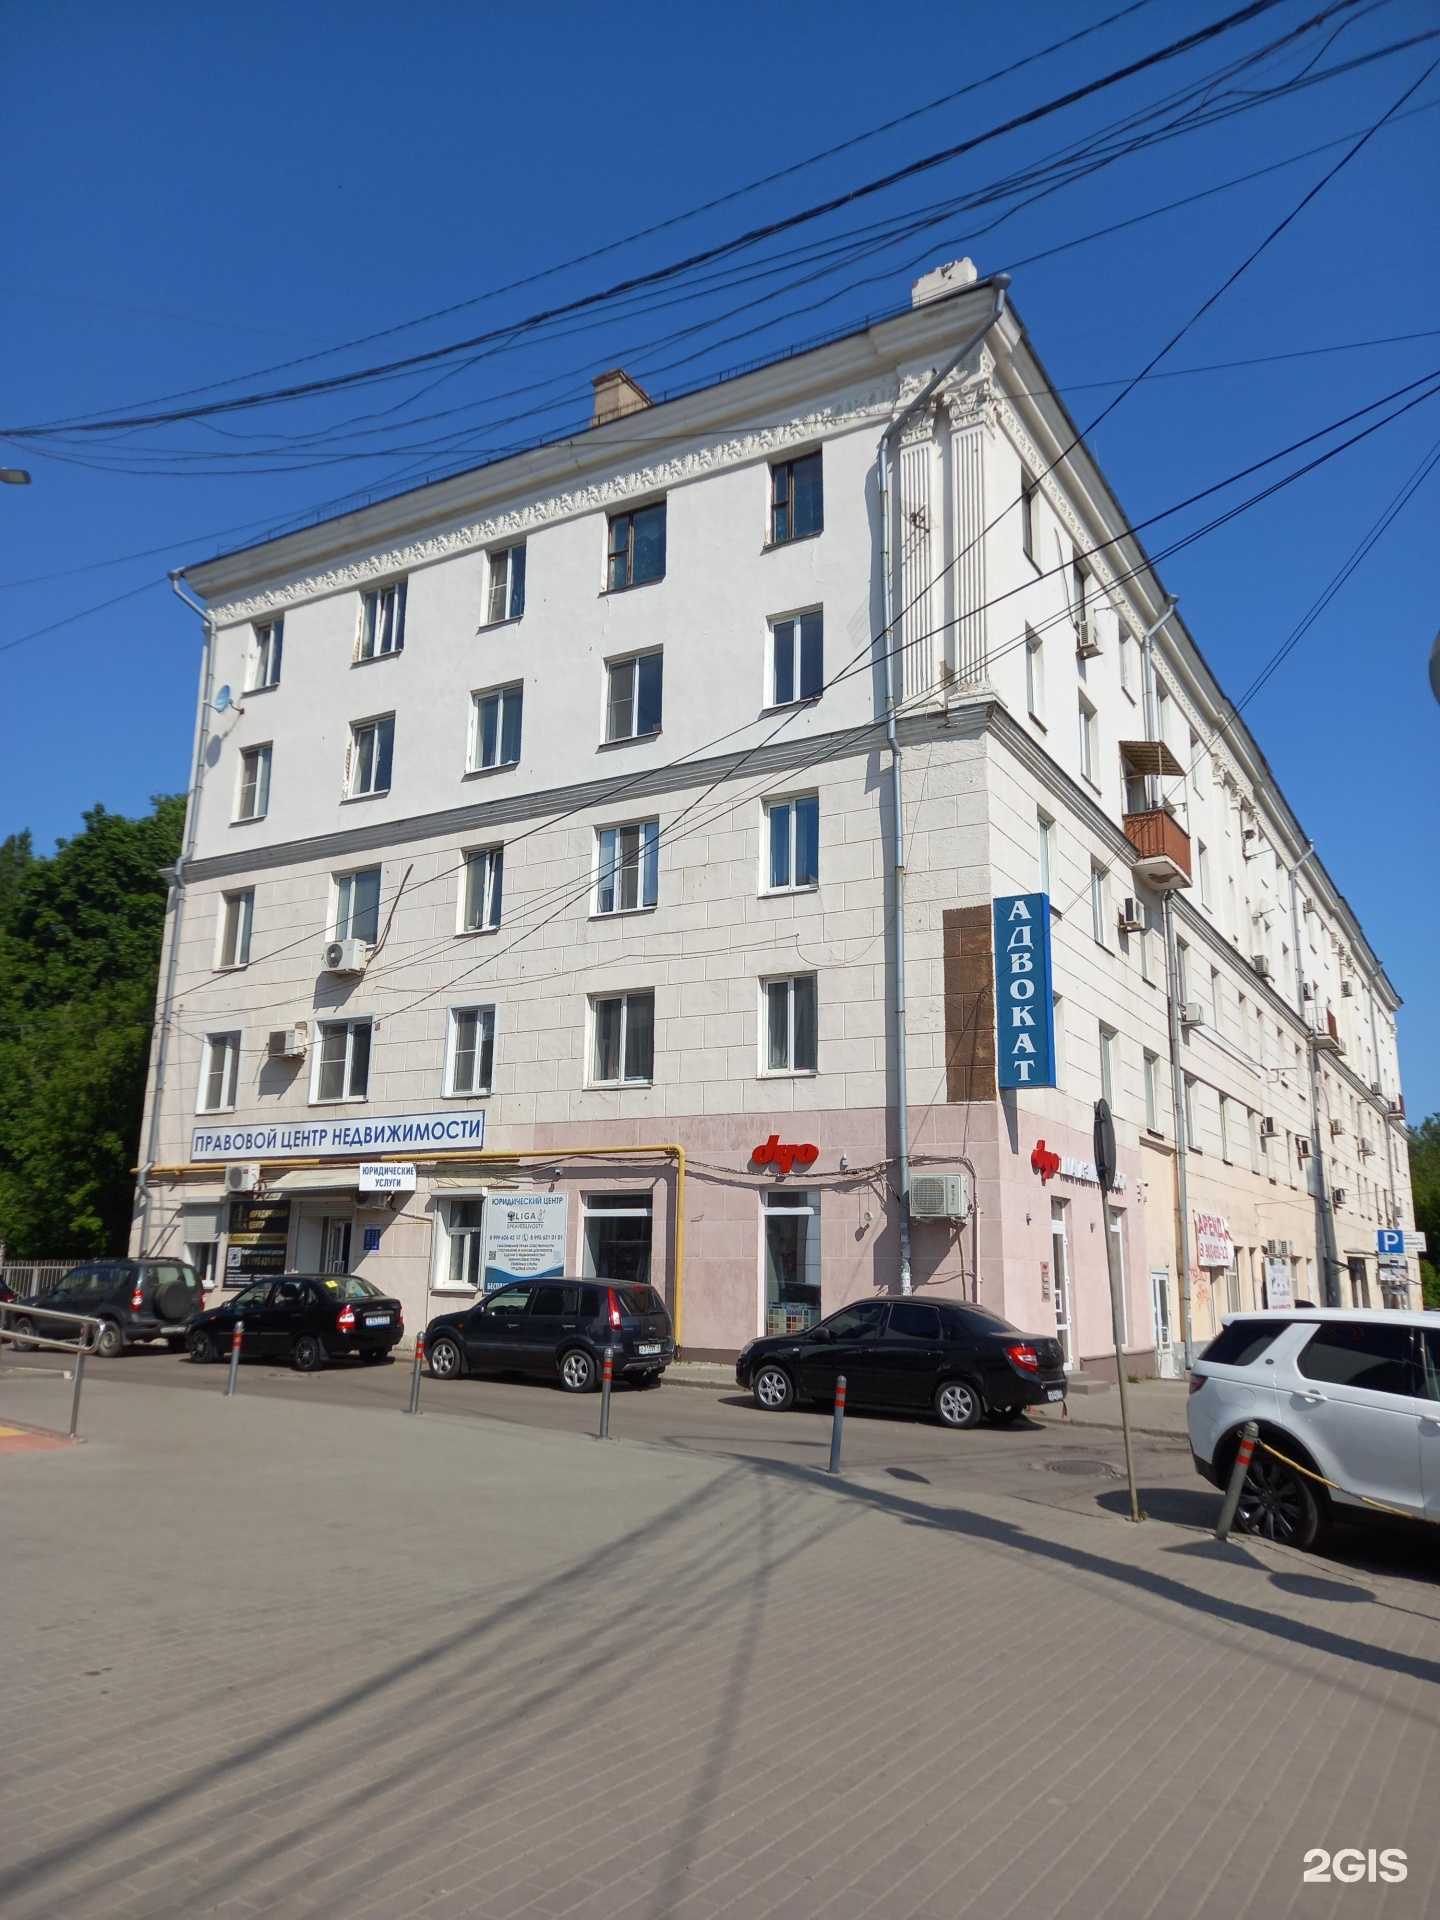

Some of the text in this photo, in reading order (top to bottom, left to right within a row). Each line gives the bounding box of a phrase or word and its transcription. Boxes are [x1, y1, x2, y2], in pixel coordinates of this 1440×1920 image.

[1007, 900, 1037, 1081] АДВОКАТ
[194, 1119, 481, 1152] ПРАВОВОЙ ЦЕНТР НЕДВИЖИМОСТИ
[362, 1166, 415, 1176] ЮРИДИЧЕСКИЕ
[375, 1179, 401, 1188] УСЛУГИ
[491, 1196, 563, 1206] ЮРИДИЧЕСКИЙ ЦЕНТР
[515, 1212, 536, 1220] LIGA
[1384, 1231, 1399, 1251] P
